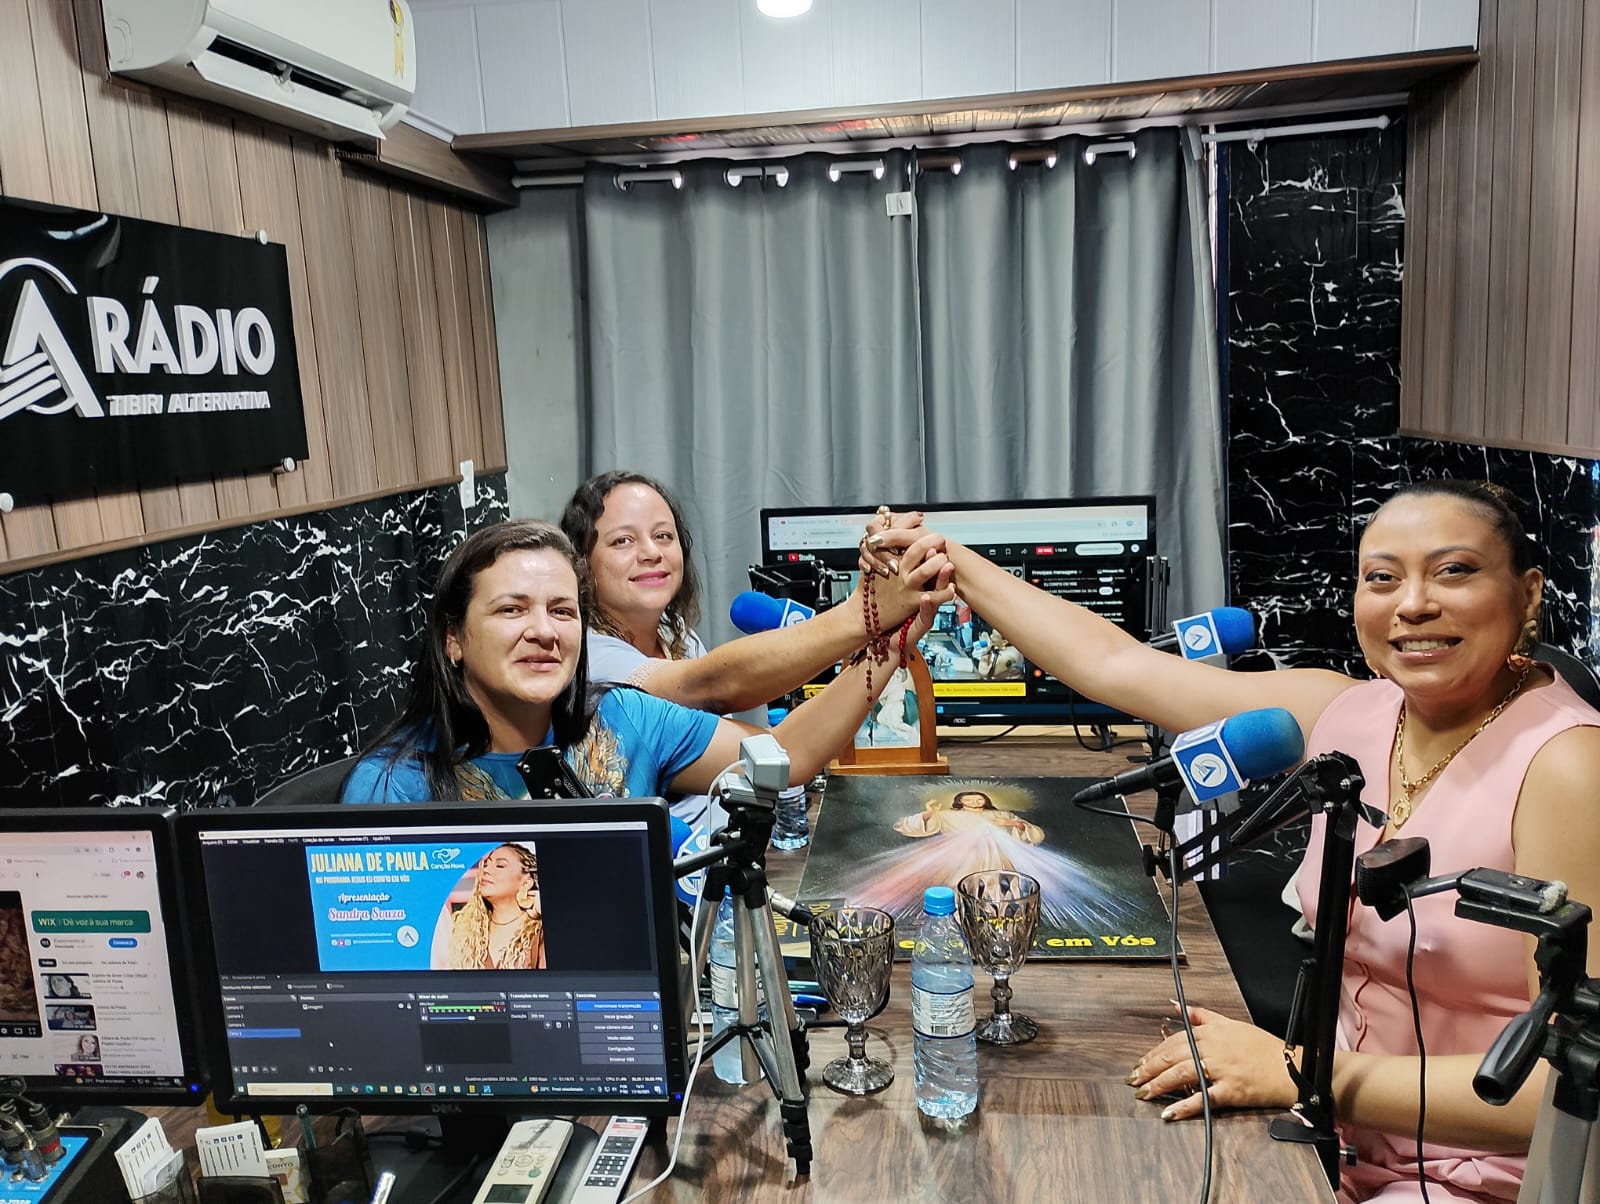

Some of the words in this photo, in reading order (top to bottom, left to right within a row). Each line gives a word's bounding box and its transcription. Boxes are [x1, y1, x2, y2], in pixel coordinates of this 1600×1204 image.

[87, 276, 275, 376] RÁDIO
[167, 391, 271, 414] ALTERNATIVA
[311, 852, 364, 873] JULIANA
[366, 852, 385, 872] DE
[386, 851, 430, 871] PAULA
[338, 892, 391, 904] Apresentação
[328, 907, 369, 921] Sandra
[371, 906, 406, 920] Souza
[38, 918, 56, 927] WIX
[63, 917, 75, 926] Dê
[1047, 937, 1093, 947] em
[1100, 935, 1157, 947] Vós
